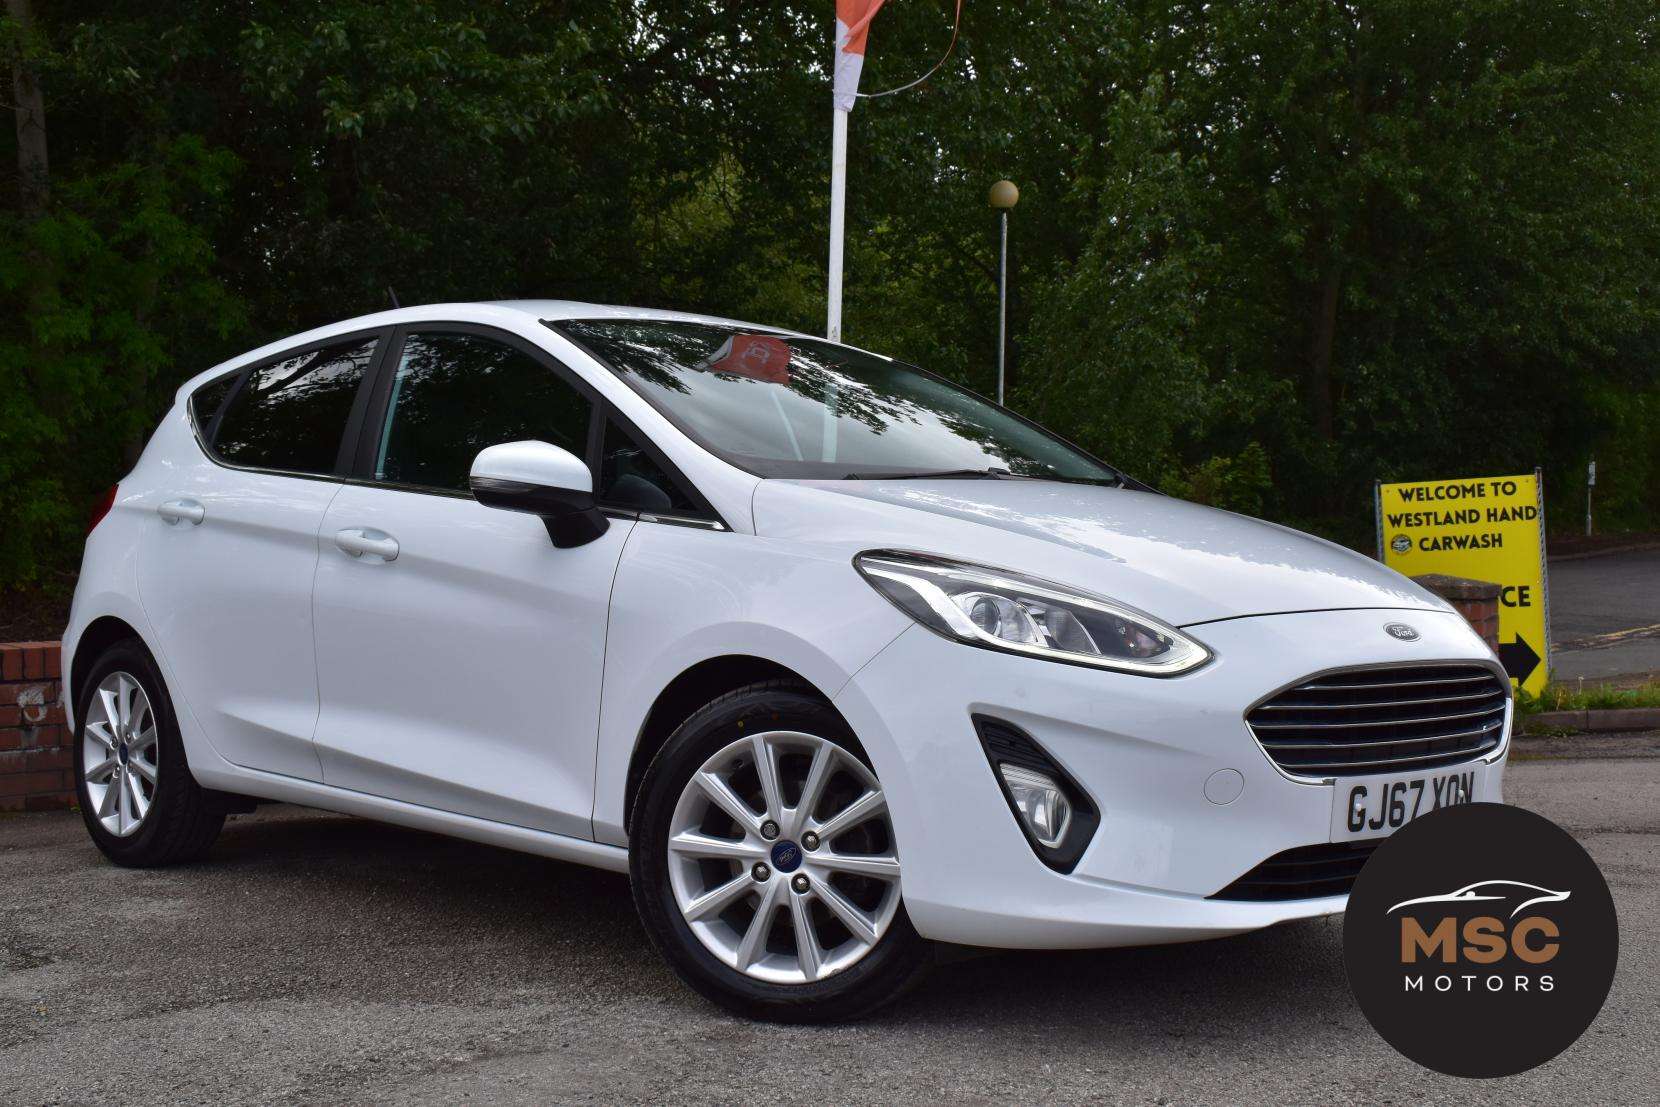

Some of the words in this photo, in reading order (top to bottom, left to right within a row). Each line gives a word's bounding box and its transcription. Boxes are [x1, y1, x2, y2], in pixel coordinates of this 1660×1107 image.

[1398, 485, 1485, 501] WELCOME
[1491, 481, 1517, 496] TO
[1387, 509, 1480, 528] WESTLAND
[1487, 506, 1537, 522] HAND
[1419, 533, 1503, 551] CARWASH
[1500, 585, 1531, 607] CE
[1347, 779, 1425, 832] GJ67
